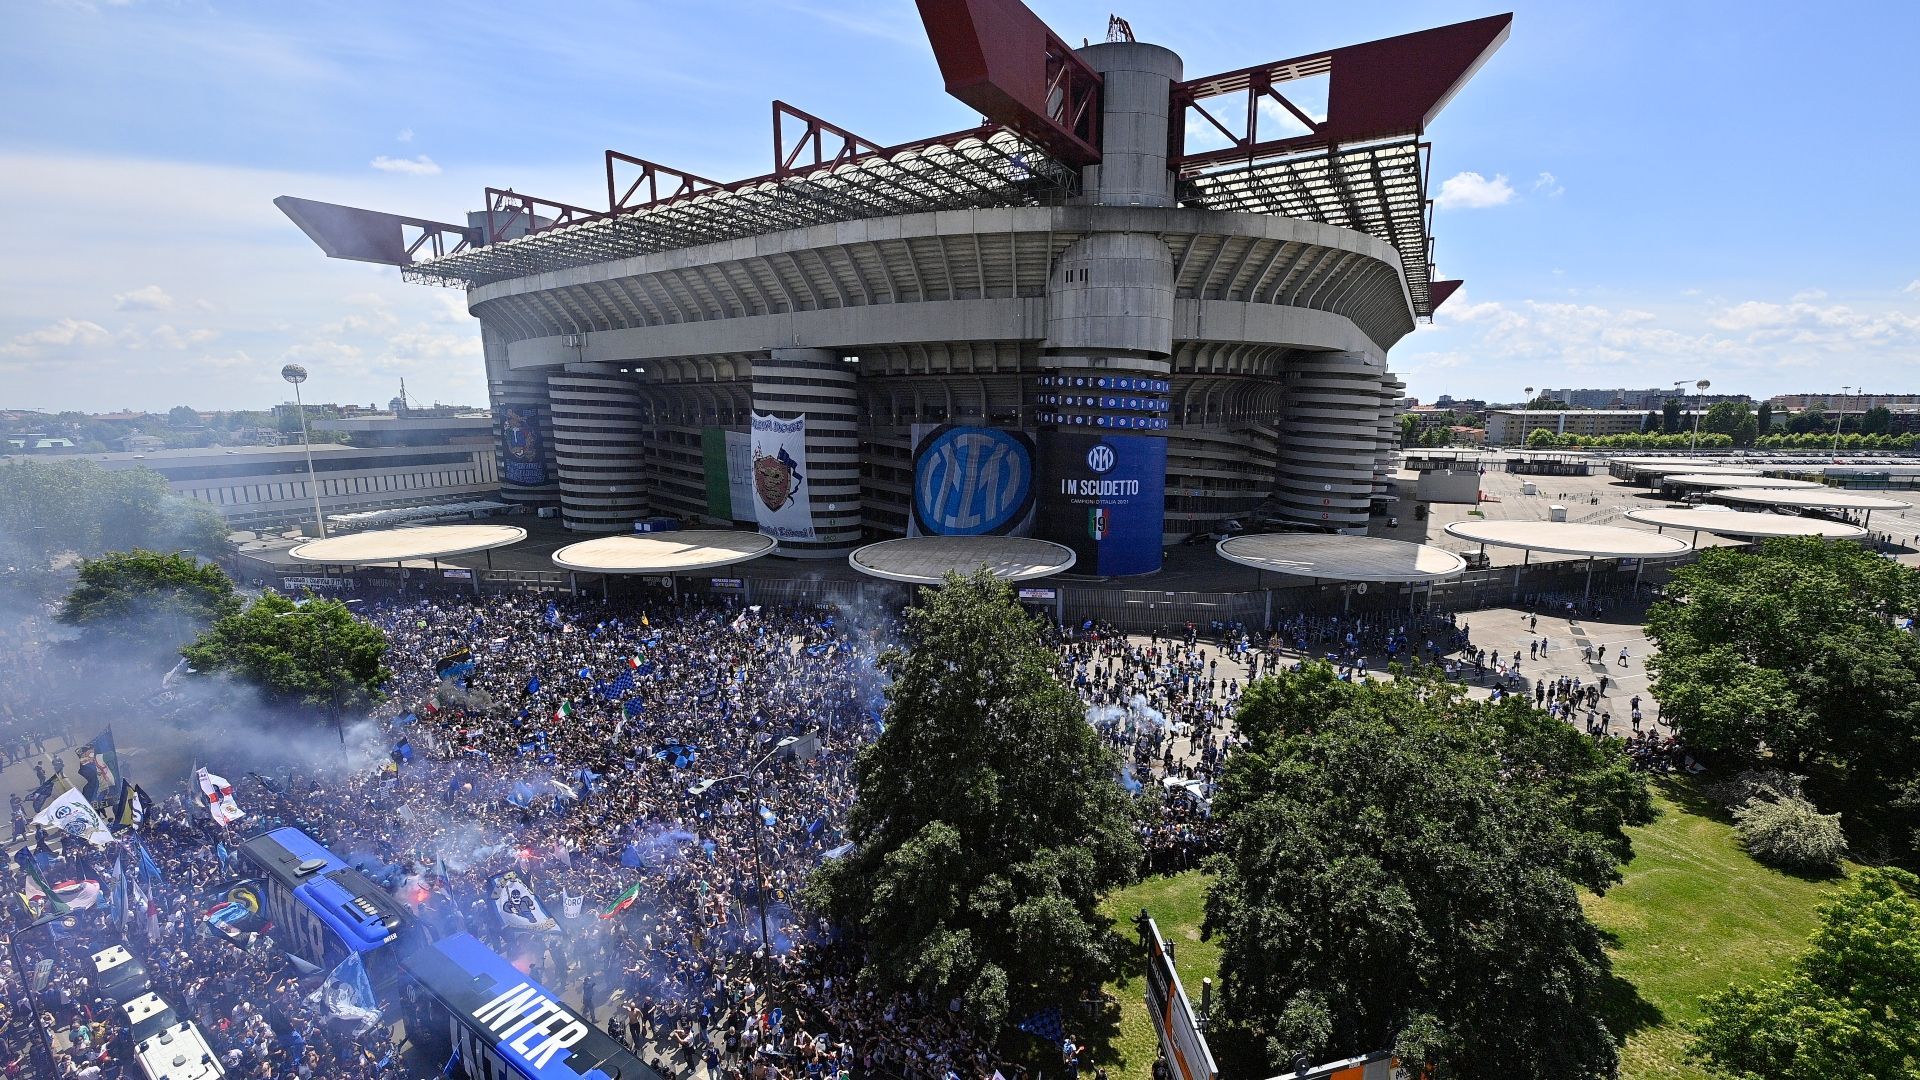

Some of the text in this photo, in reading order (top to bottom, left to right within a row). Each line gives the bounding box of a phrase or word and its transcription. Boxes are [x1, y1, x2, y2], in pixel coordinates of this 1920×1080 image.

[1061, 479, 1139, 496] I M SCUDETTO
[1092, 516, 1106, 532] 19
[383, 932, 398, 944] INTER
[471, 982, 589, 1070] INTER
